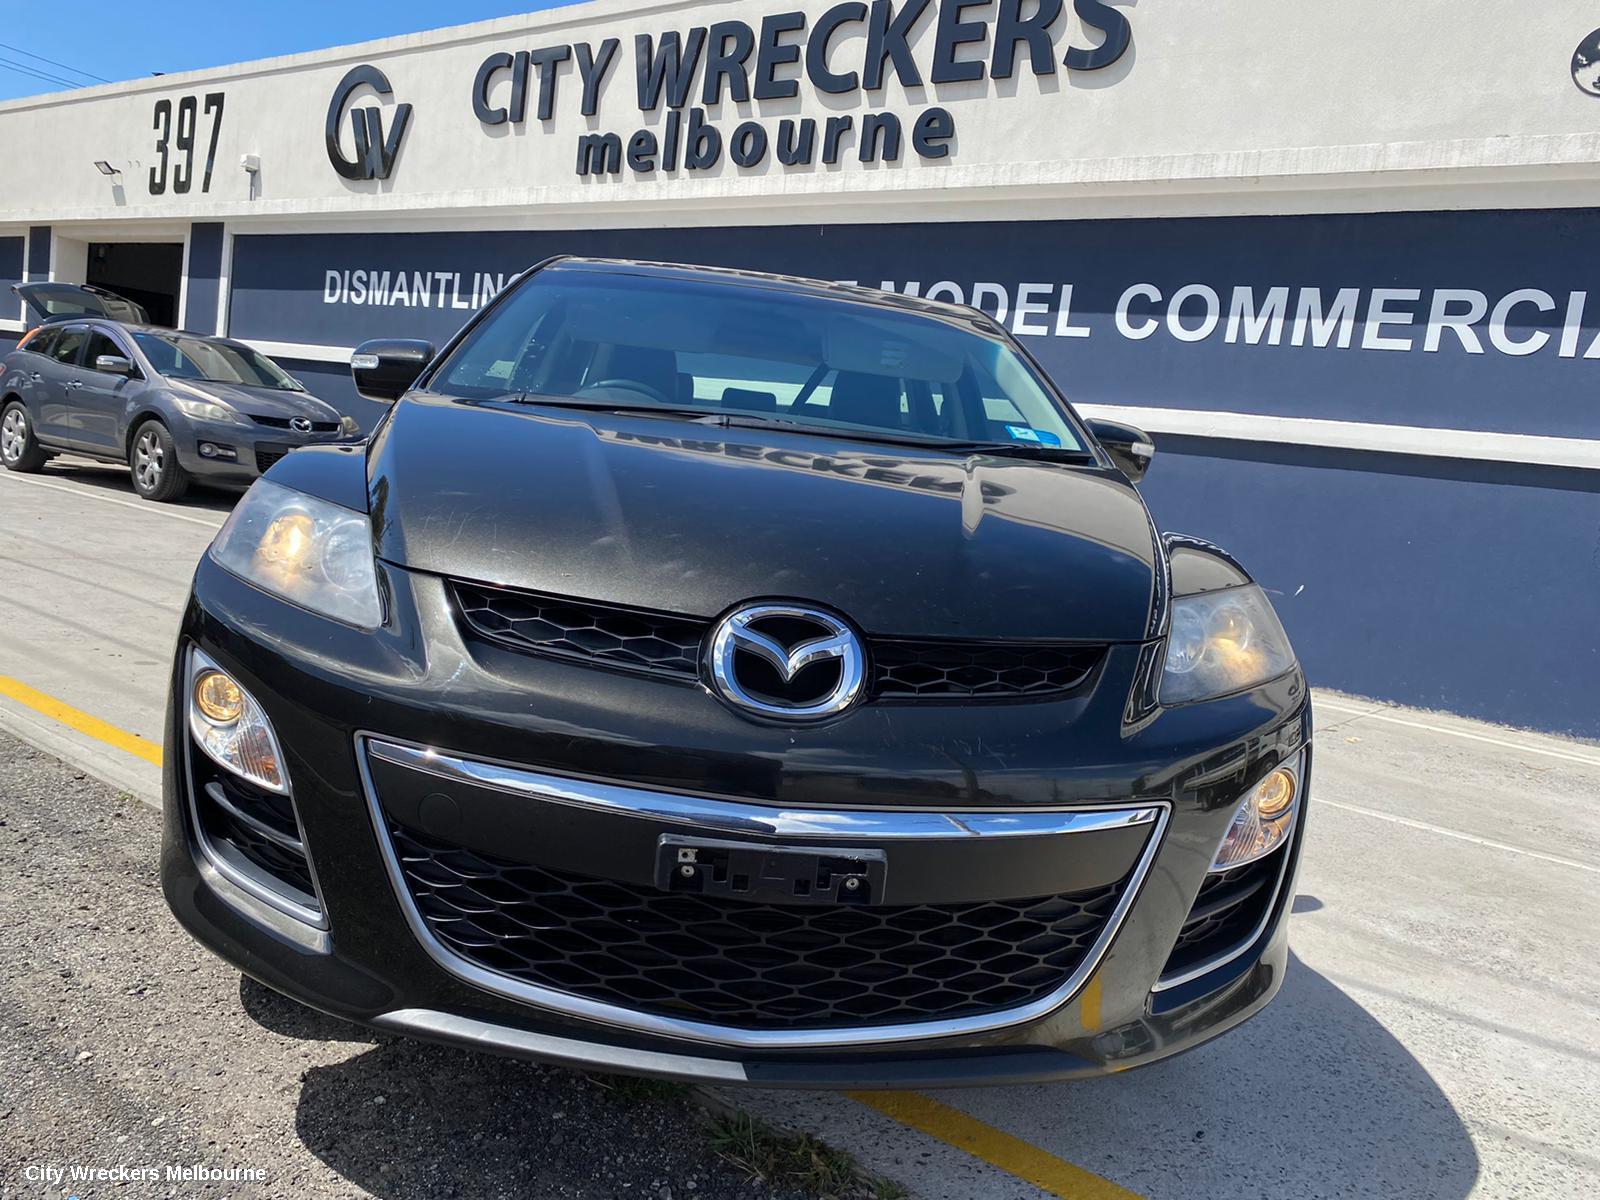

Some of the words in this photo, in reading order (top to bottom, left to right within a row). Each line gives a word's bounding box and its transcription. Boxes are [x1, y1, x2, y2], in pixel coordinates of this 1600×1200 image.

[472, 38, 621, 125] CITY
[635, 0, 1132, 111] WRECKERS
[149, 92, 225, 195] 397
[576, 107, 955, 176] melbourne
[1115, 283, 1600, 359] COMMERCI
